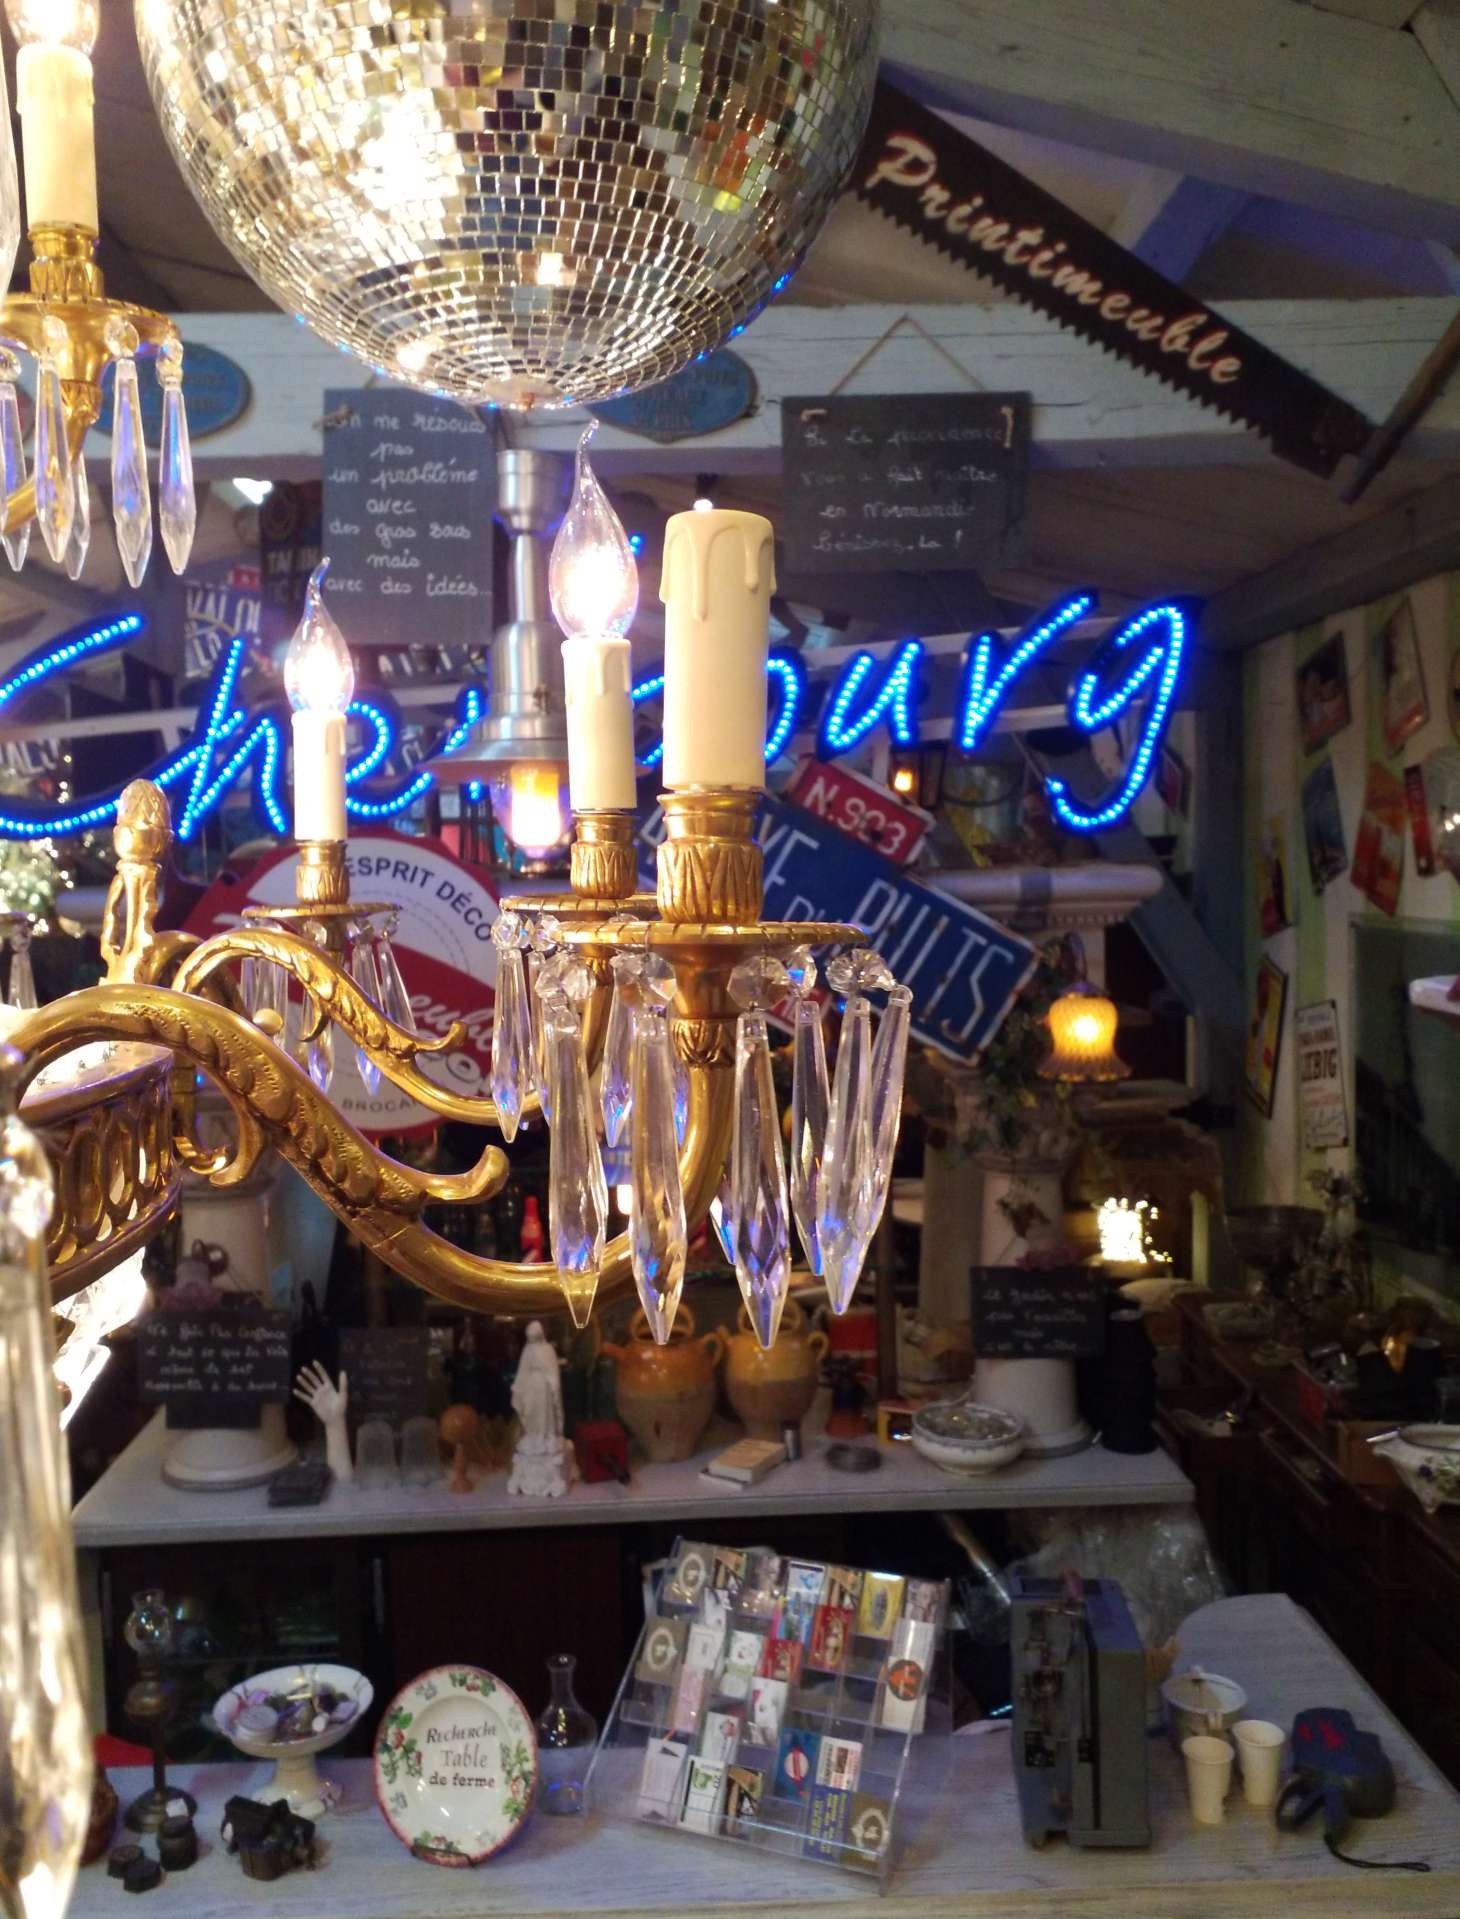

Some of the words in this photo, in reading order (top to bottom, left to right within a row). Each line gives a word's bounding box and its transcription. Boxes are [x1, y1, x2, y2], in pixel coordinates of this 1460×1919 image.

[865, 132, 1242, 384] Printimeuble
[369, 442, 414, 462] pas
[328, 467, 359, 483] un
[366, 498, 416, 515] avec
[329, 518, 360, 535] des
[366, 548, 421, 568] mais
[325, 577, 363, 592] avec
[380, 576, 413, 594] des
[342, 1096, 423, 1113] BROCA
[426, 1722, 496, 1744] Recherche
[441, 1744, 488, 1769] Table
[429, 1772, 448, 1787] de
[452, 1771, 496, 1788] ferme
